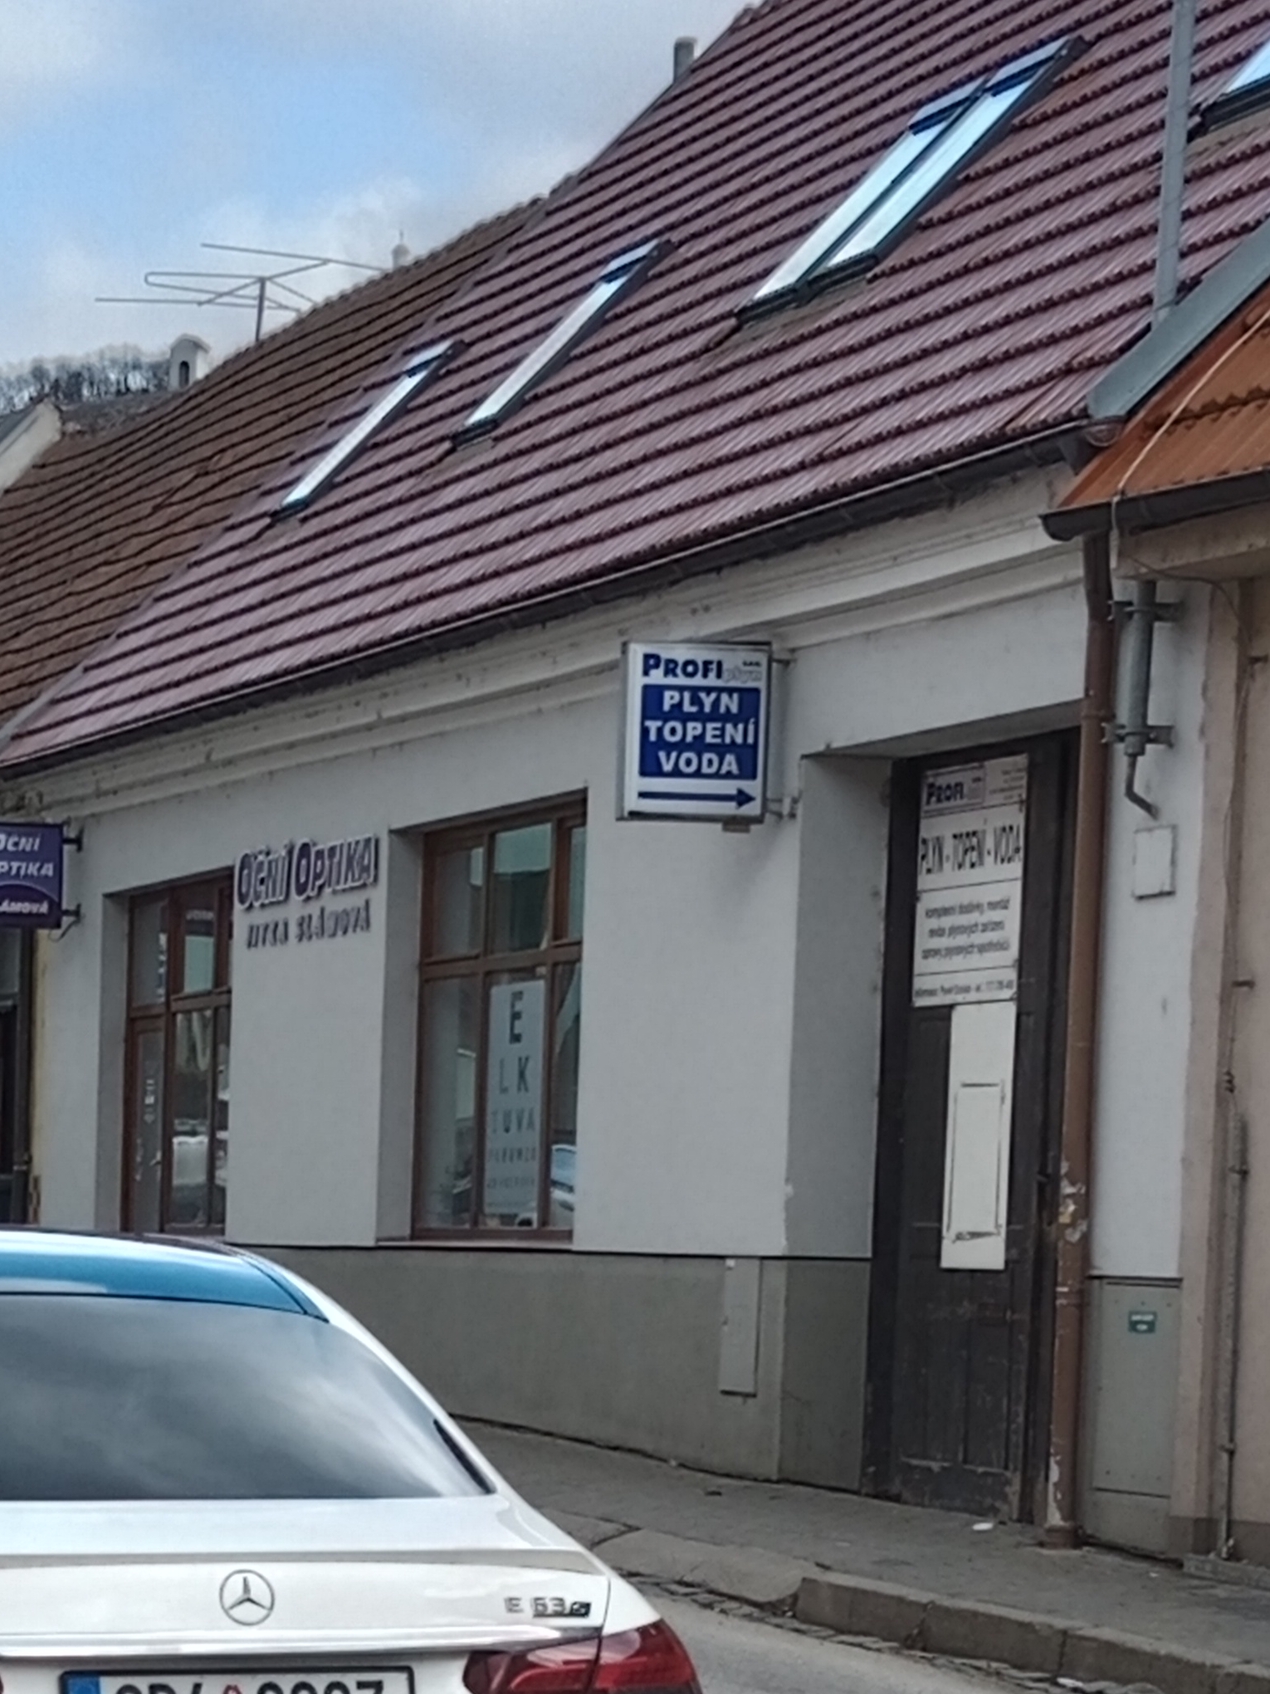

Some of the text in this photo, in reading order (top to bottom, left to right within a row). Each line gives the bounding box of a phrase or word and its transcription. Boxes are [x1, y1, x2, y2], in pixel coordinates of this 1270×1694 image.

[642, 653, 723, 680] PROFI
[662, 690, 739, 715] PLYN
[644, 717, 756, 745] TOPENÍ
[658, 751, 740, 776] VODA
[293, 834, 378, 901] OPTIKA
[509, 991, 524, 1045] E
[504, 1597, 524, 1614] E
